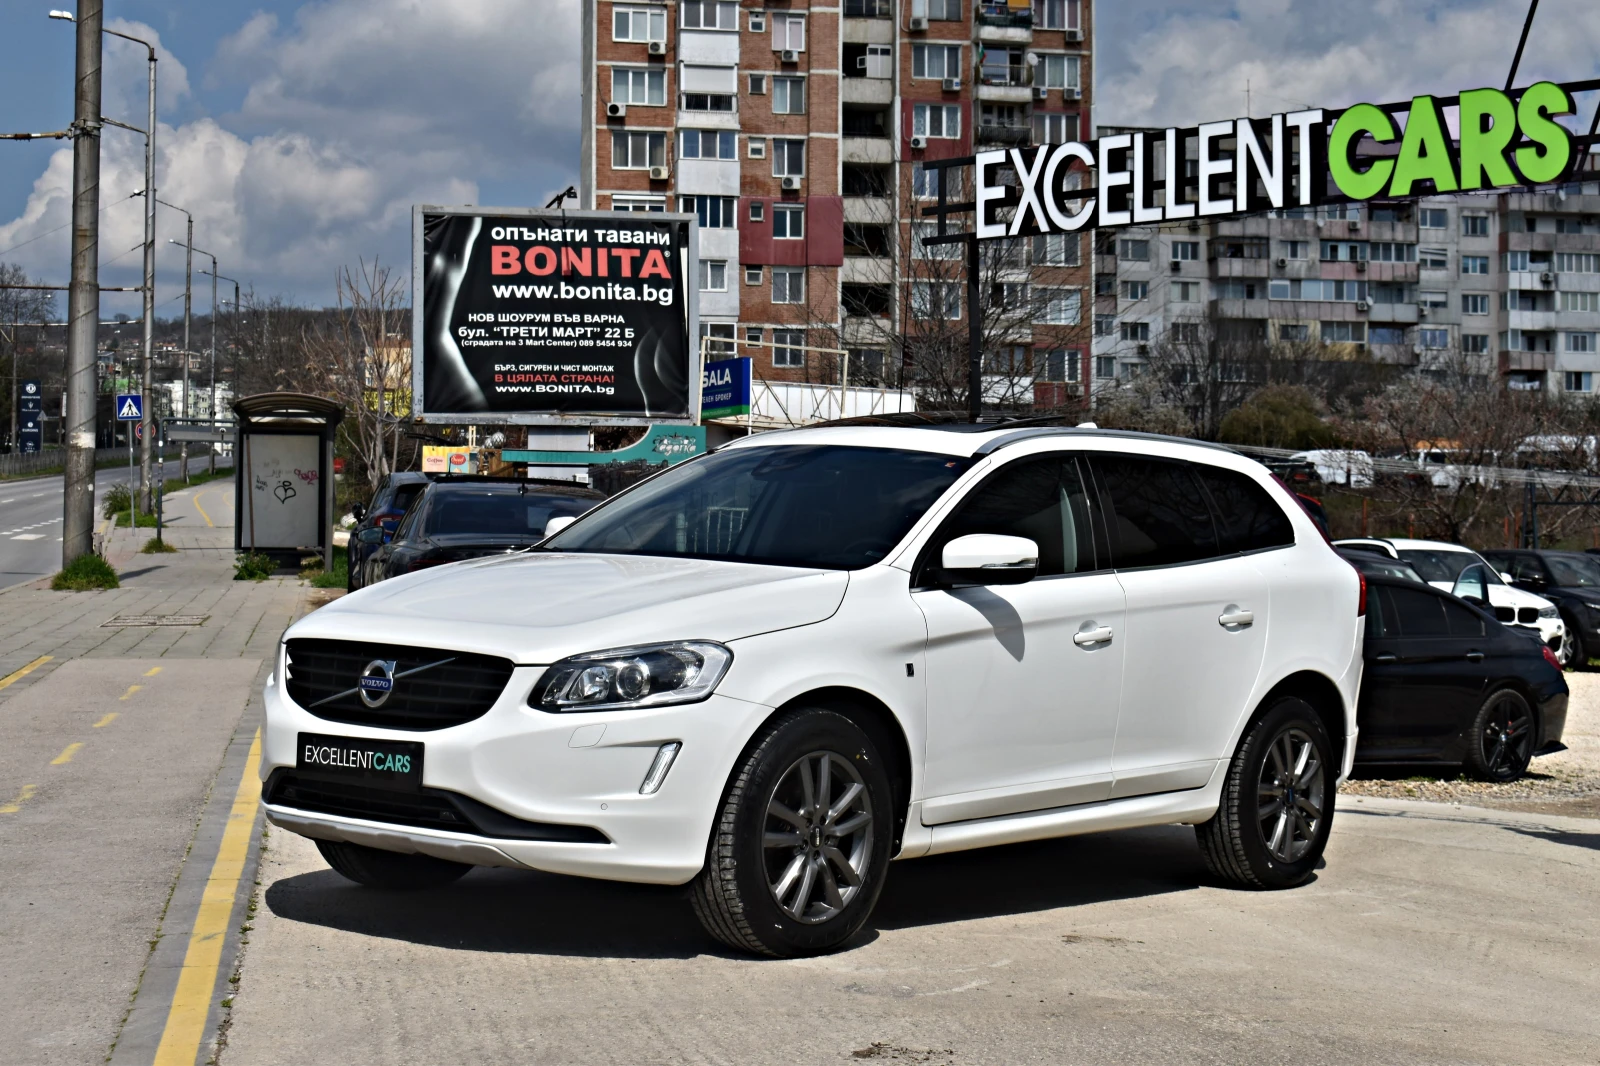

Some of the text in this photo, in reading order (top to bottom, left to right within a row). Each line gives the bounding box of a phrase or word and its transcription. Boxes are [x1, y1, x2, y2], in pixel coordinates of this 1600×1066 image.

[976, 81, 1571, 239] EXCELLENT CARS
[491, 227, 671, 245] опънати тавани
[492, 281, 673, 306] www.bonita.bg
[468, 313, 625, 324] НОВ ШОУРУМ ВЪВ ВАРНА
[458, 326, 489, 340] бул.
[604, 328, 621, 338] 22
[624, 328, 635, 338] Б
[461, 339, 504, 347] (сградата
[546, 339, 577, 347] Center)
[518, 364, 552, 372] СИГУРЕН
[494, 374, 615, 384] В ЦЯЛАТА СТРАНА!
[495, 384, 615, 395] www.BONITA.bg
[361, 678, 389, 688] VOLVO
